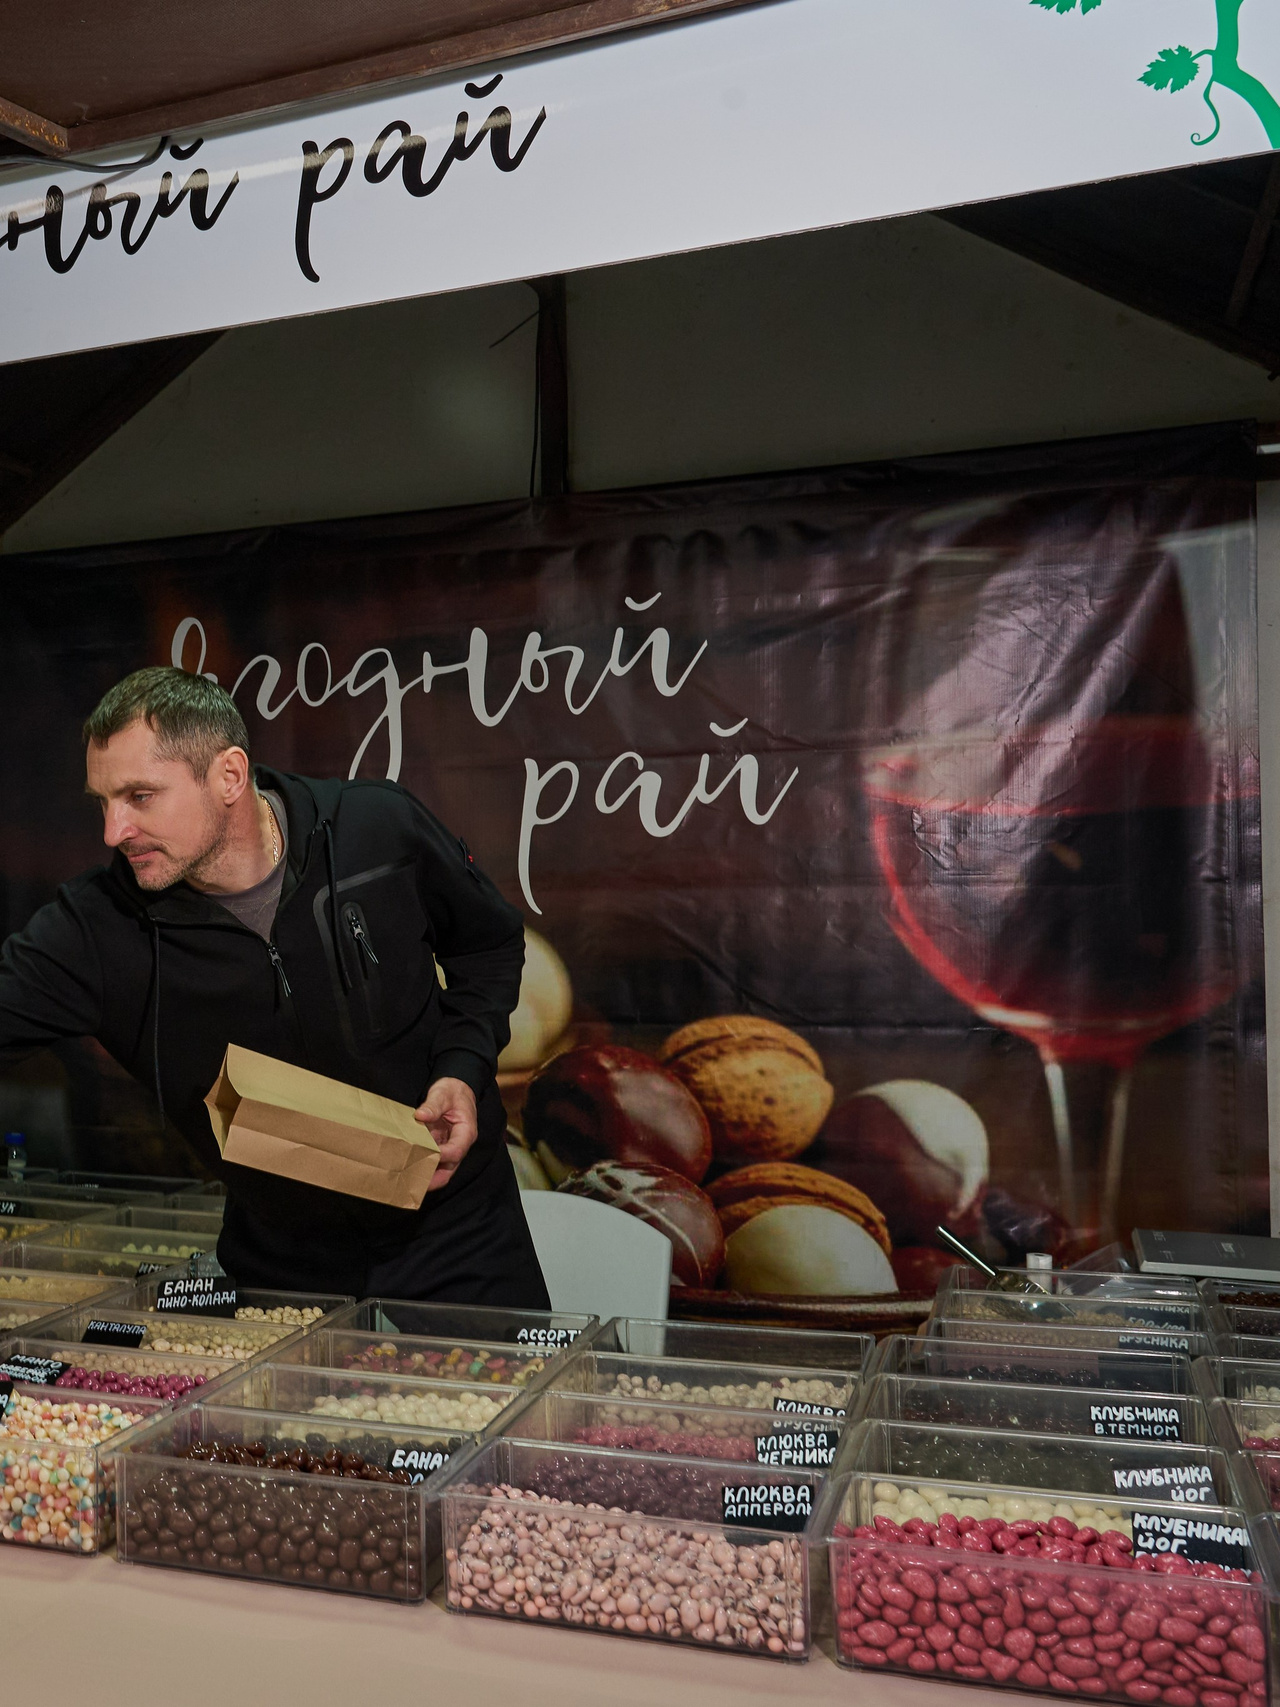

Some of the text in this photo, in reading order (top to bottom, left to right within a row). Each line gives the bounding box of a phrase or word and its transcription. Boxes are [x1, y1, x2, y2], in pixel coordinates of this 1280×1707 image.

[295, 73, 546, 284] рай
[519, 717, 798, 915] рай
[163, 1278, 214, 1296] БАНАН
[156, 1290, 236, 1310] ПИНО-КОЛАДА
[87, 1320, 147, 1335] КАНТАЛУПА
[516, 1328, 582, 1343] АССОРТ
[10, 1354, 63, 1369] МАНГО
[1090, 1405, 1180, 1423] КЛУБНИКА
[757, 1433, 828, 1453] КЛЮКВА
[391, 1448, 450, 1471] БАНА
[1113, 1465, 1213, 1489] КЛУБНИКА
[724, 1485, 810, 1505] КЛЮКВА
